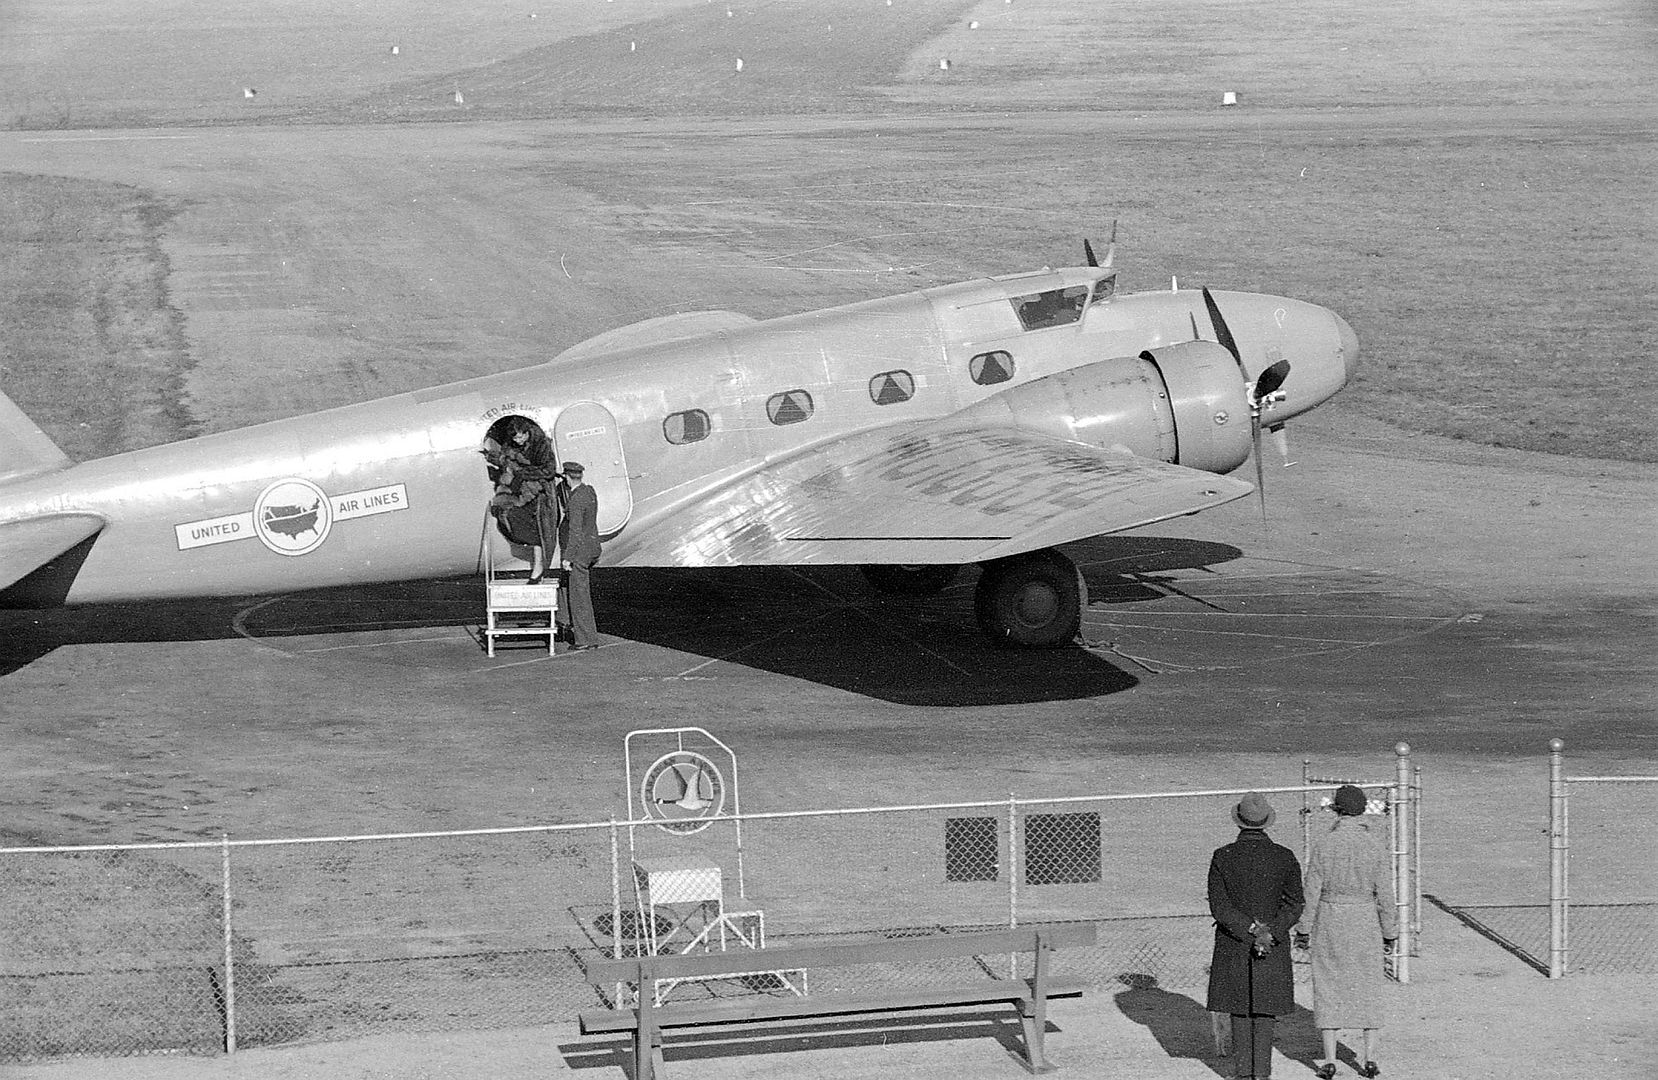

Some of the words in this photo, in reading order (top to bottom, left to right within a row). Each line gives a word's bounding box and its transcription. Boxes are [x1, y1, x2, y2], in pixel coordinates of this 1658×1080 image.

[338, 500, 360, 513] AIR
[363, 492, 400, 509] LINES
[191, 521, 240, 540] UNITED
